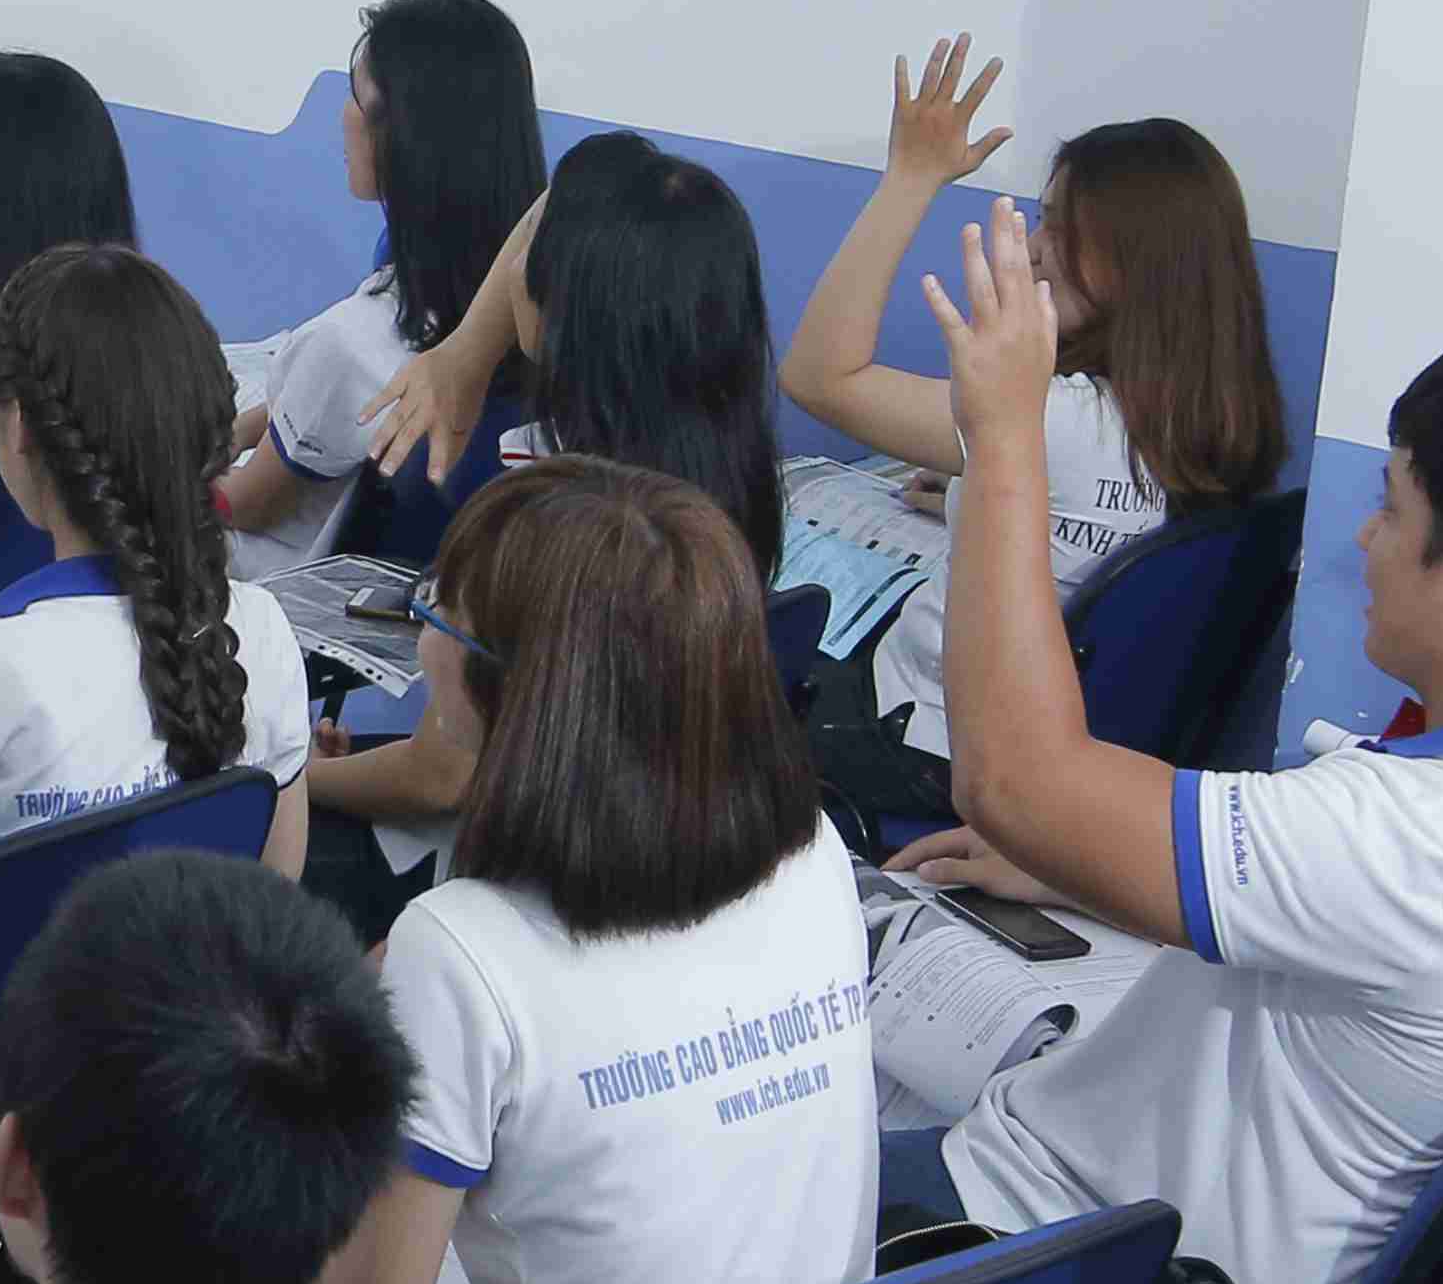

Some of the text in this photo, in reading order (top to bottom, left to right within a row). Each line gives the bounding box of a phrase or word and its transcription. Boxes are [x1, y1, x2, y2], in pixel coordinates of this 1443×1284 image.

[1055, 517, 1117, 556] KINH
[578, 1048, 676, 1110] TRƯỜNG
[675, 1035, 719, 1085] CAO
[717, 1006, 771, 1070] ĐẲNG
[768, 991, 821, 1057] QUỐC
[817, 977, 845, 1036] TẾ
[715, 1063, 832, 1126] www.ich.edu.vn
